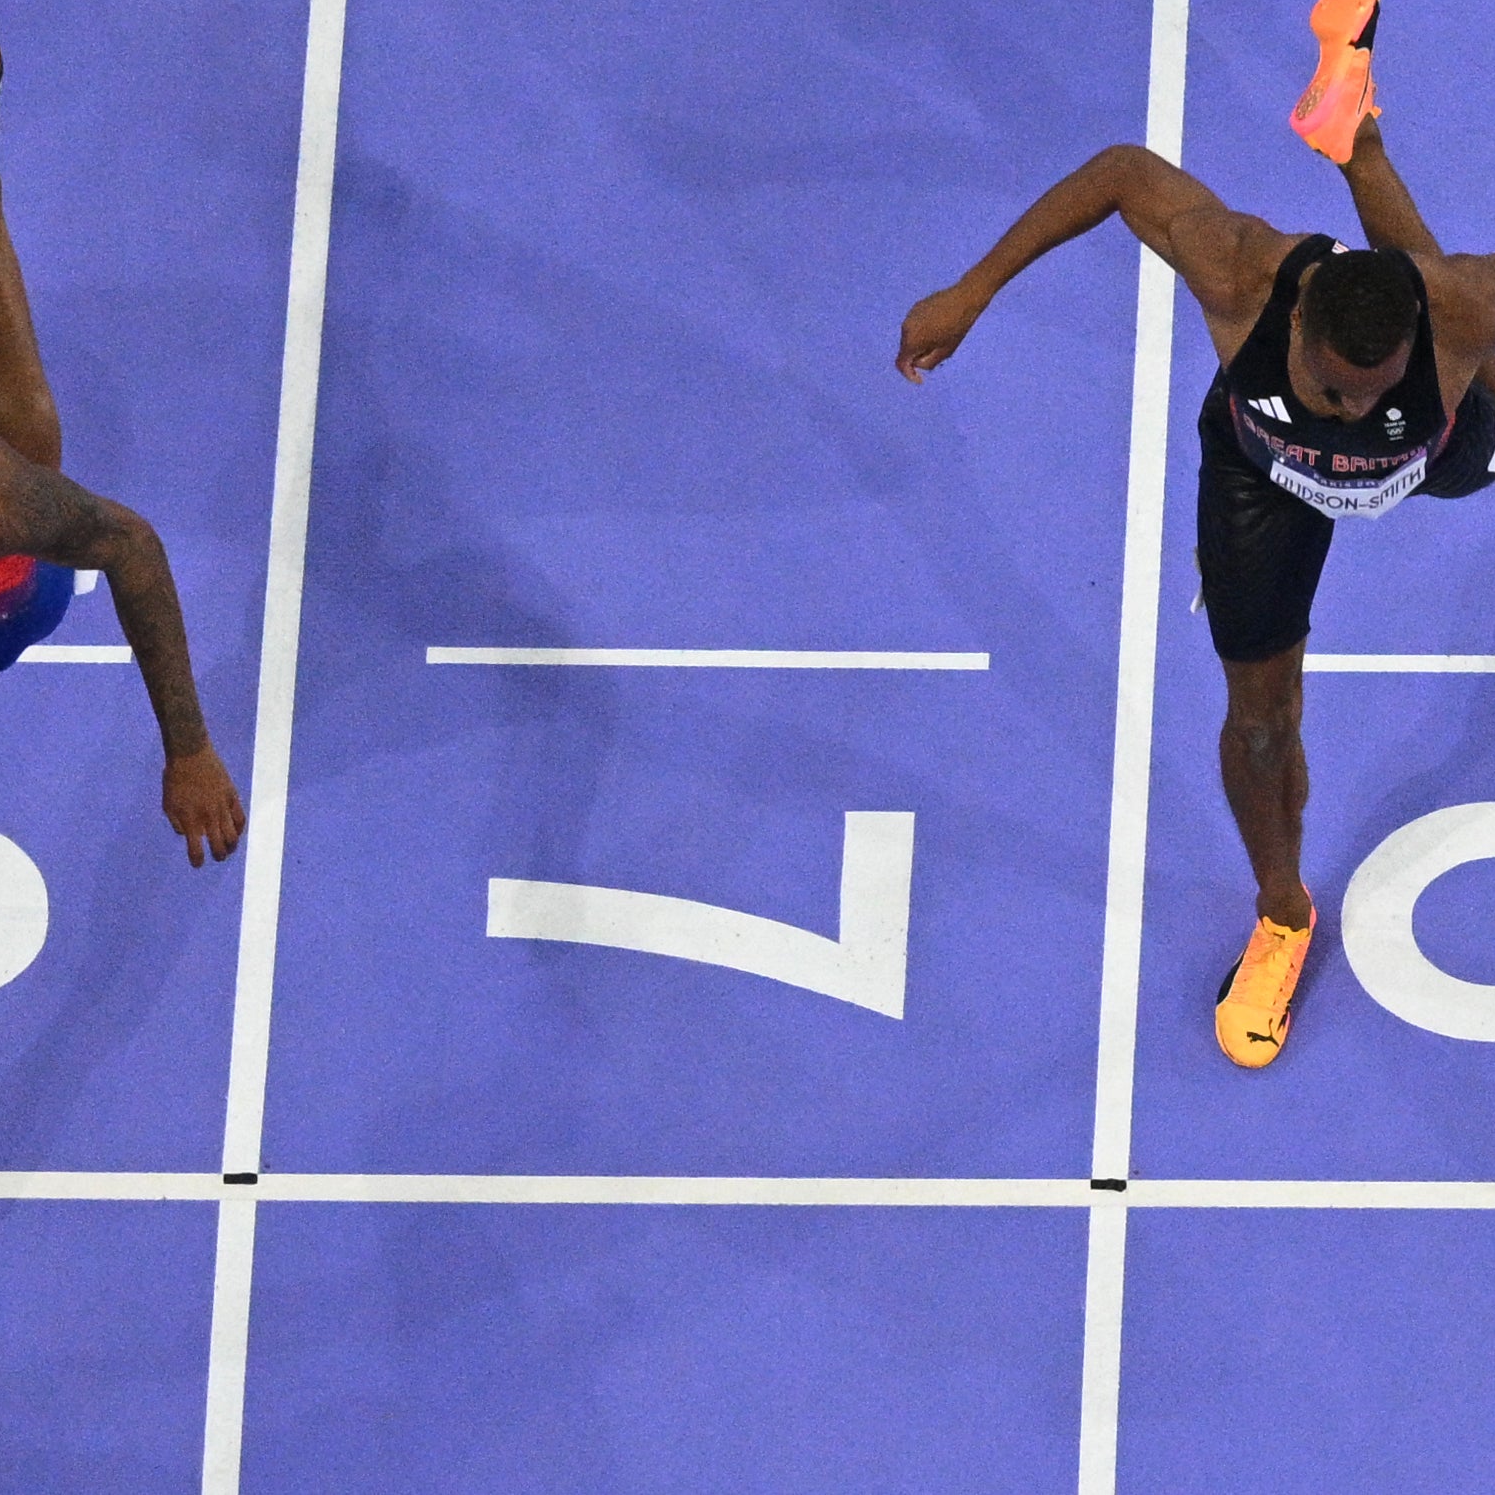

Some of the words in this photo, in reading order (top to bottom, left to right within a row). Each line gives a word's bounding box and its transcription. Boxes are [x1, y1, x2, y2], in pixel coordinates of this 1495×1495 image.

[1243, 413, 1321, 466] GREAT
[1276, 466, 1421, 510] HUDSON-SMITH
[486, 811, 915, 1021] 7
